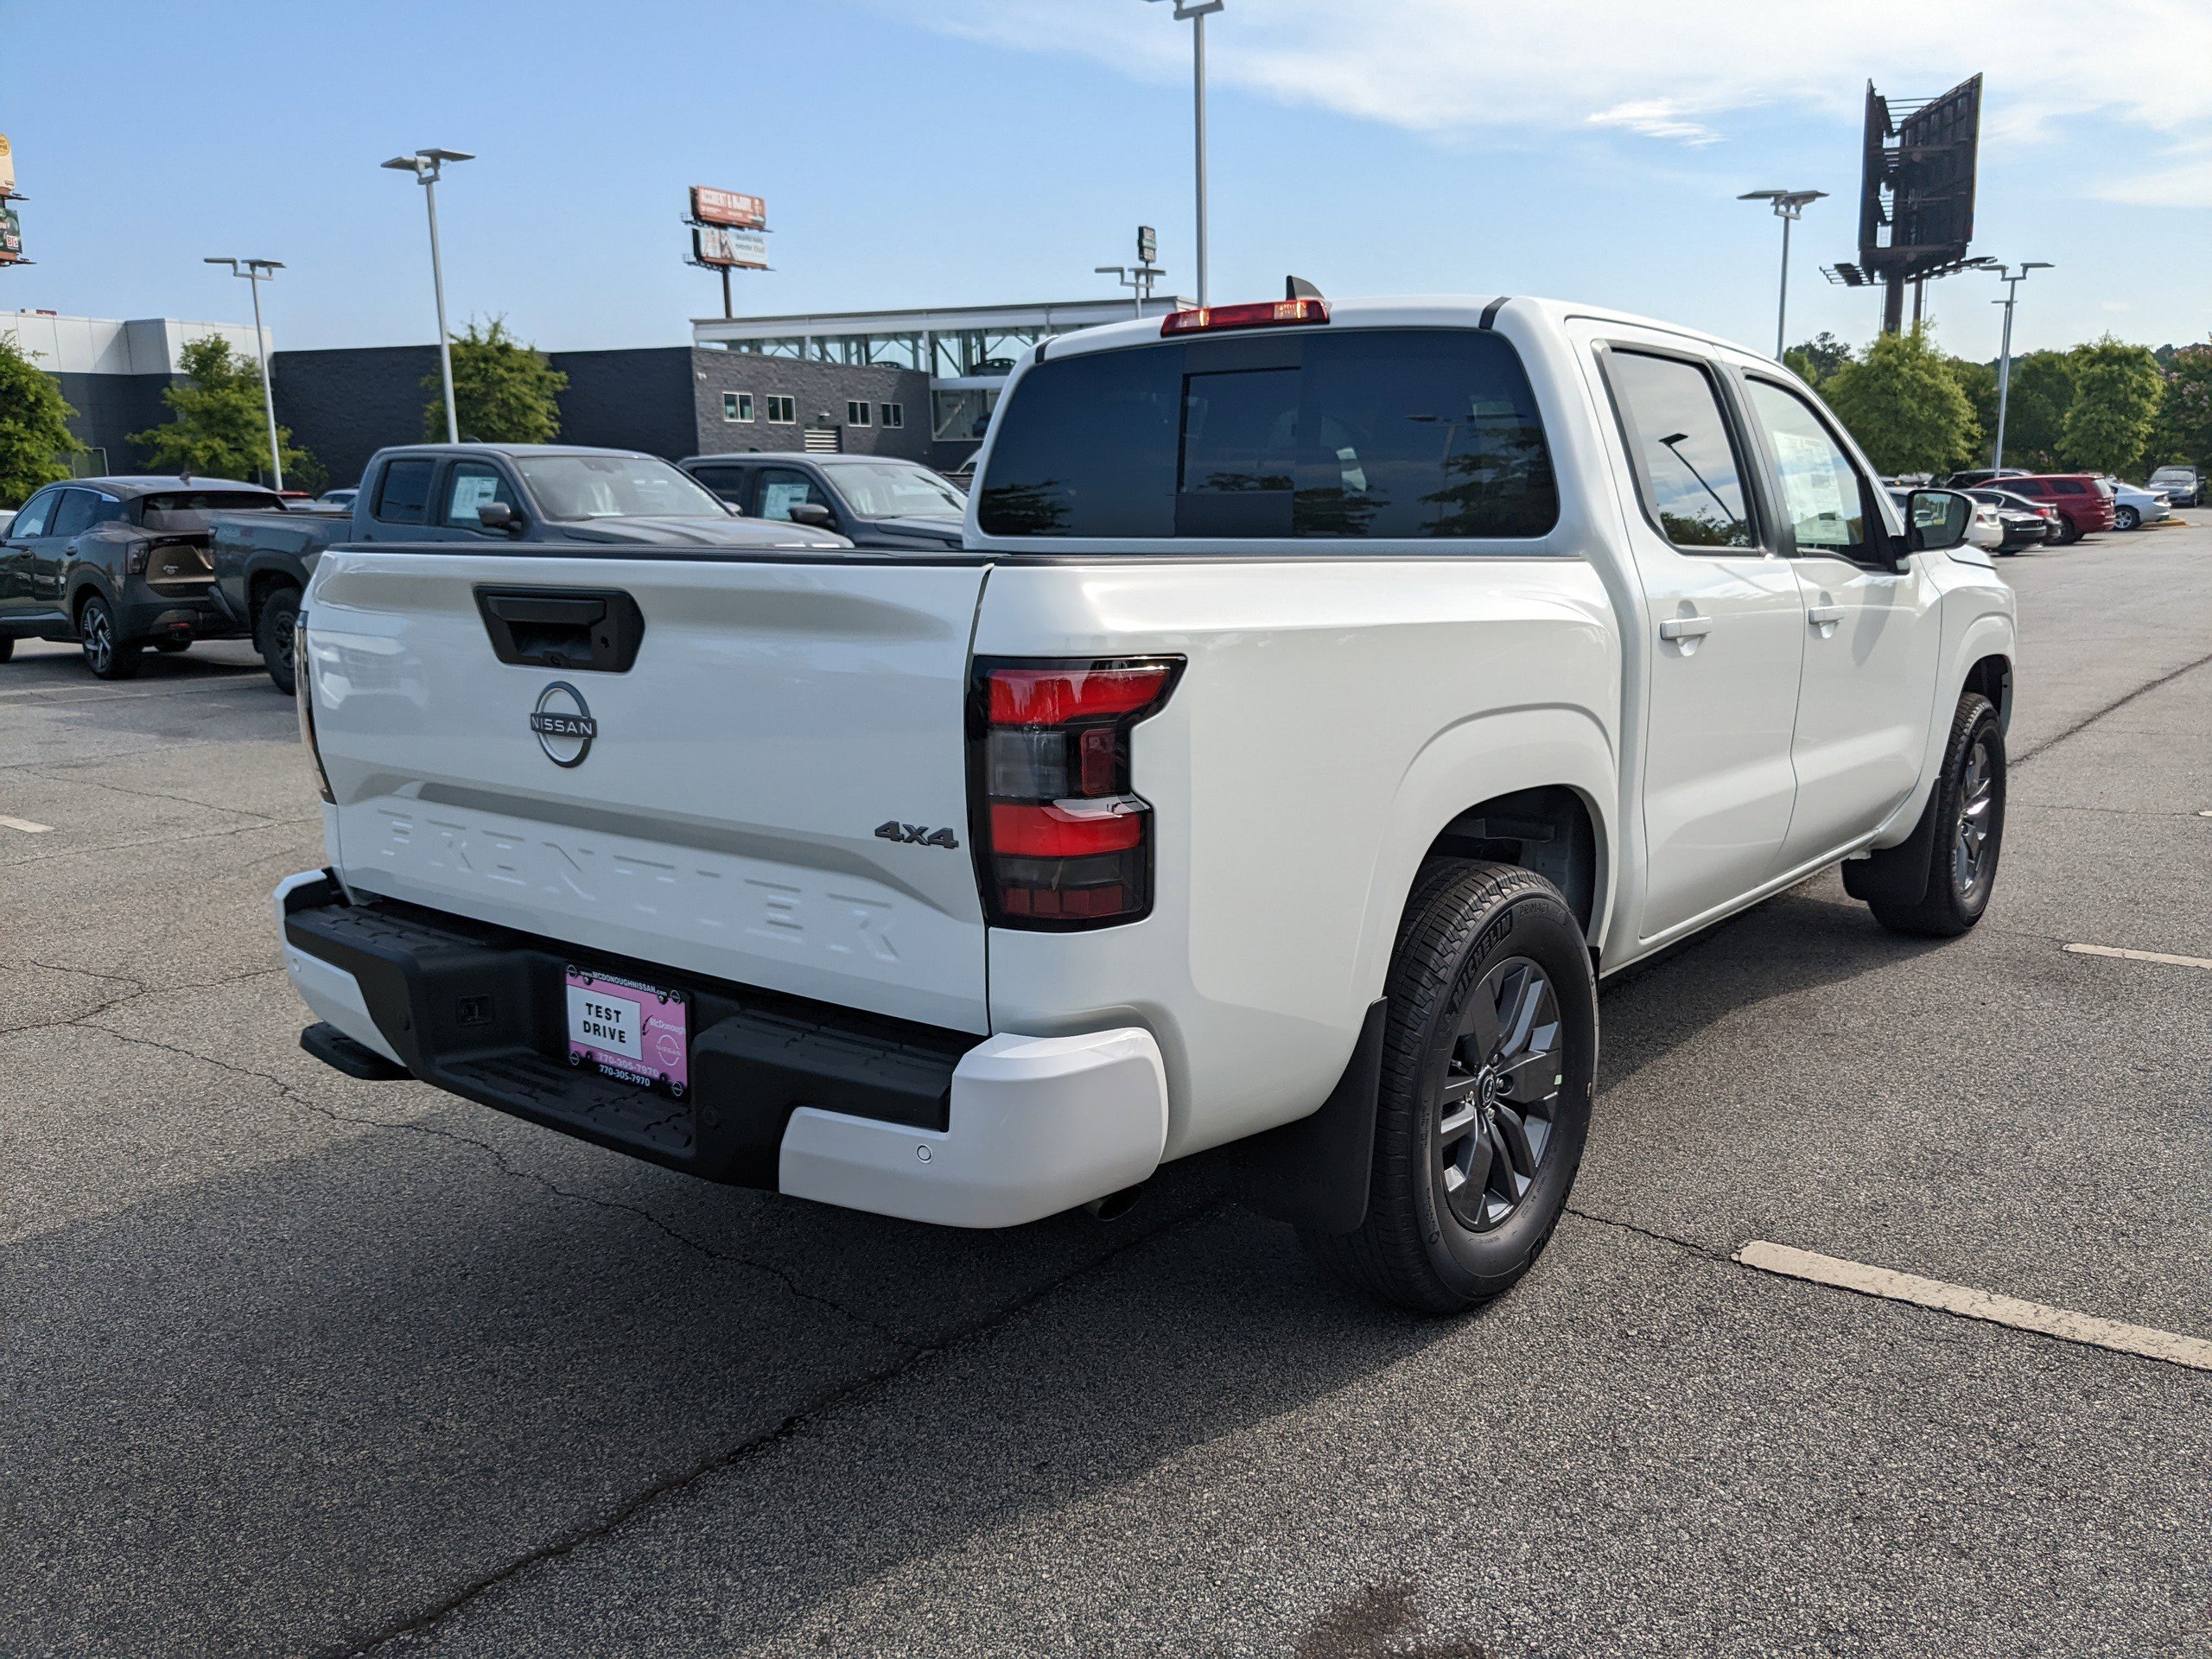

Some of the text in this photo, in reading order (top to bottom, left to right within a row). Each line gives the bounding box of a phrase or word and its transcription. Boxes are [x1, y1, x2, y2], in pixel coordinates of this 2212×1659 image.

[531, 716, 592, 734] NISSAN
[377, 809, 900, 962] FRONTIER
[1452, 913, 1512, 1013] MICHELIN
[586, 1001, 622, 1023] TEST
[582, 1020, 626, 1044] DRIVE
[598, 1052, 659, 1077] 770-305-7970
[599, 1064, 651, 1087] 770-305-7970
